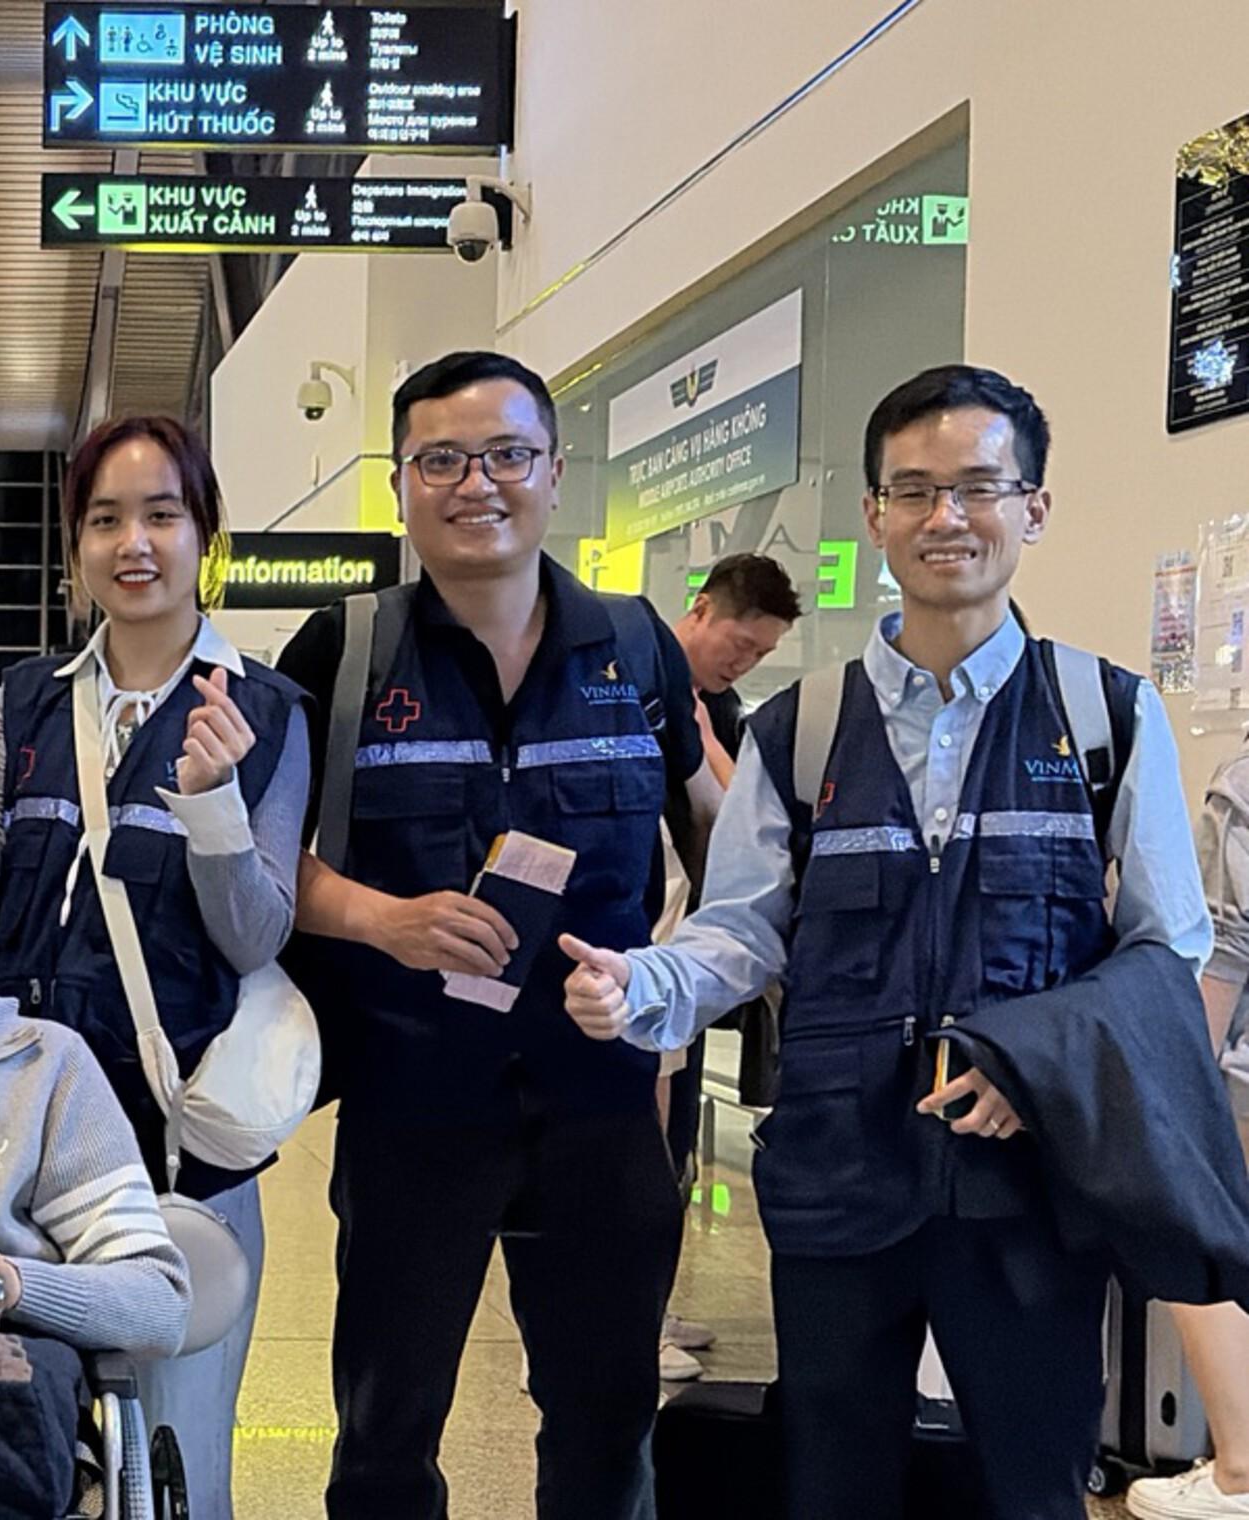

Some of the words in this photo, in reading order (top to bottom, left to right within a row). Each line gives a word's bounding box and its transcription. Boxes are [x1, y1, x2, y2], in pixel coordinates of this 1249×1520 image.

[195, 11, 275, 34] PHÒNG
[311, 35, 328, 49] Up
[331, 36, 343, 48] to
[195, 41, 223, 67] VỆ
[230, 45, 283, 65] SINH
[318, 49, 347, 61] mins
[149, 82, 195, 102] KHU
[201, 80, 247, 106] VỰC
[369, 82, 410, 95] Outdoor
[412, 83, 455, 98] smoking
[149, 110, 193, 133] HÚT
[198, 108, 275, 134] THUỐC
[310, 107, 326, 121] Up
[330, 108, 342, 120] to
[317, 121, 345, 133] mins
[149, 186, 195, 206] KHU
[201, 185, 247, 209] VỰC
[352, 183, 404, 198] Departure
[149, 208, 208, 234] XUẤT
[213, 208, 275, 235] CẢNH
[295, 209, 311, 223] Up
[314, 210, 326, 222] to
[302, 225, 330, 236] mins
[226, 556, 375, 583] nformation
[580, 683, 638, 699] VINME
[1024, 760, 1080, 775] VINM
